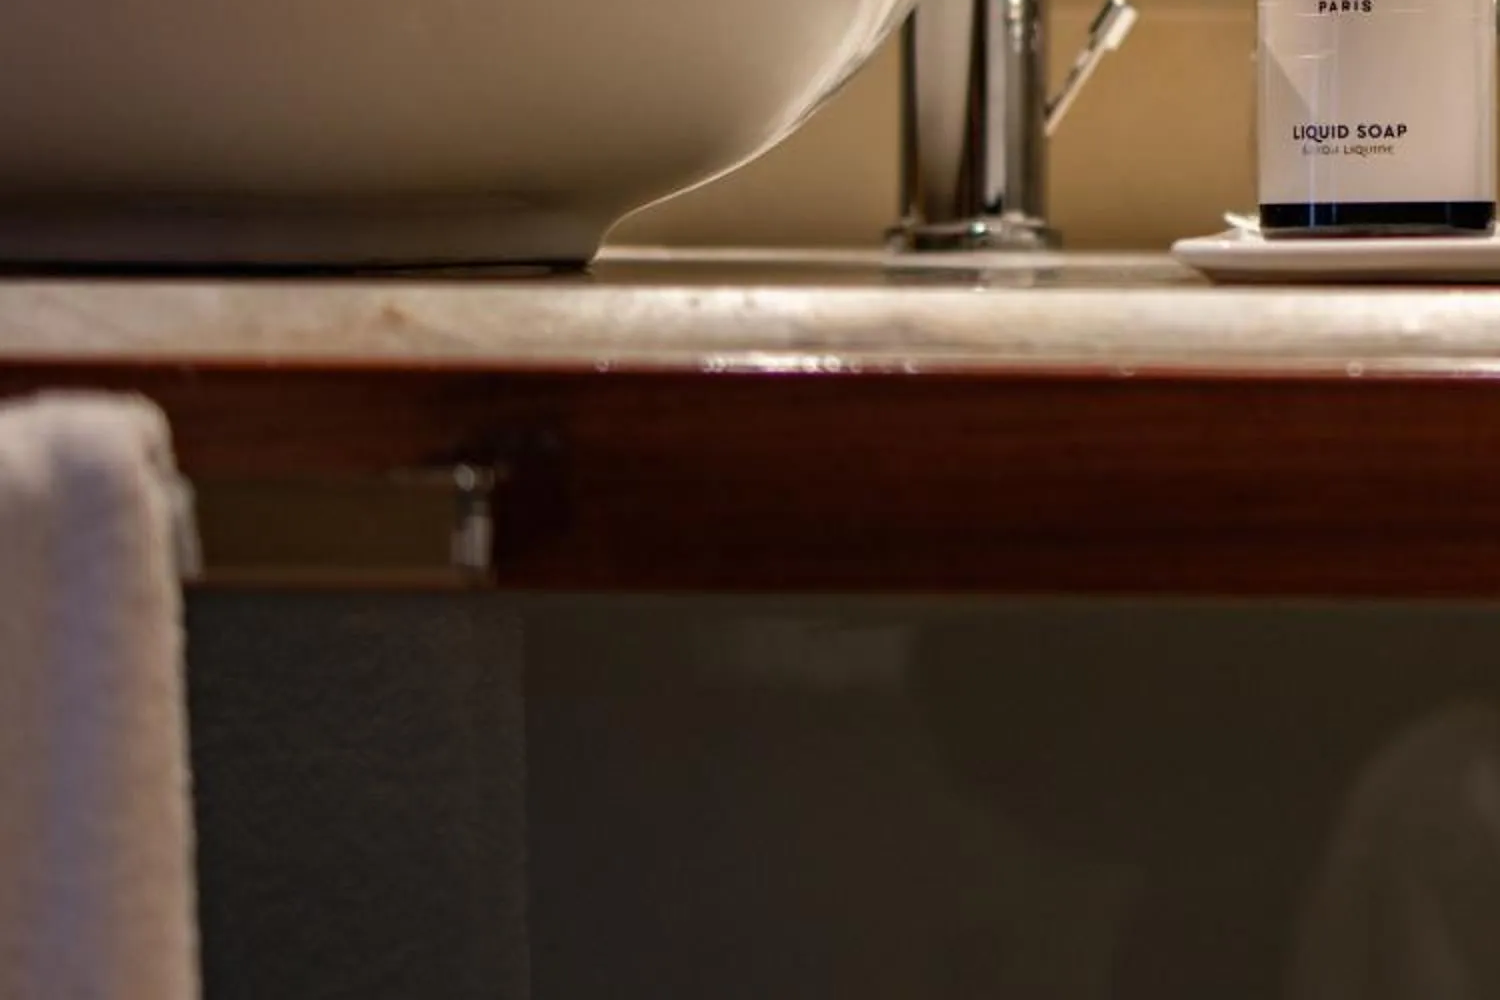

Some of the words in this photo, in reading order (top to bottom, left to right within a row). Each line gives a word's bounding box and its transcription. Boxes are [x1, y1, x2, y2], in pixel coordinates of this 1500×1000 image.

[1318, 0, 1372, 13] PARIS
[1293, 124, 1349, 143] LIQUID
[1356, 123, 1408, 139] SOAP
